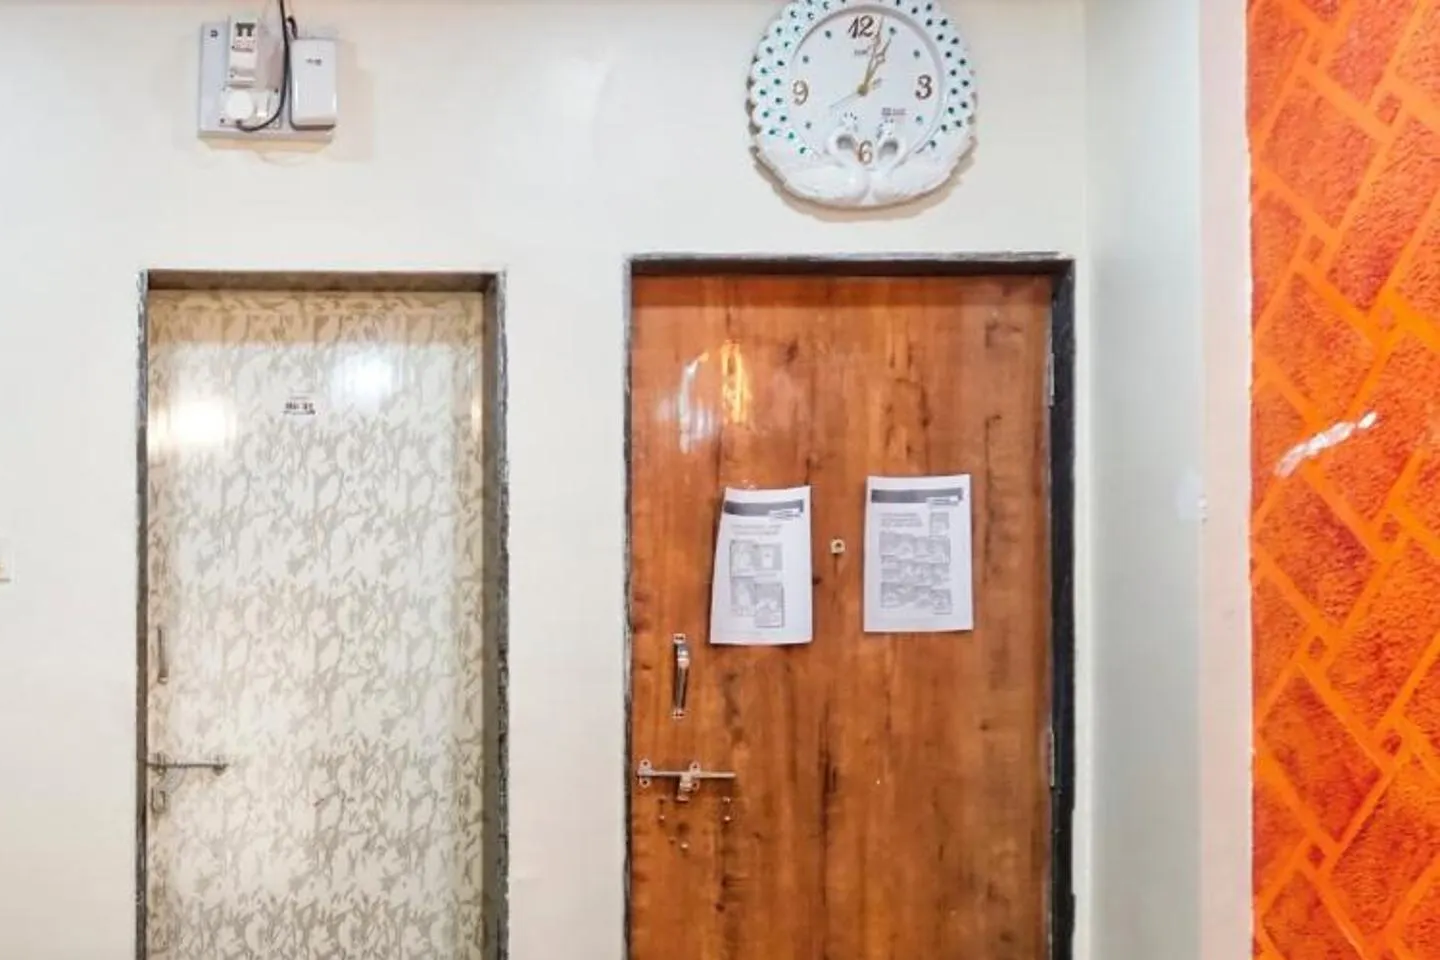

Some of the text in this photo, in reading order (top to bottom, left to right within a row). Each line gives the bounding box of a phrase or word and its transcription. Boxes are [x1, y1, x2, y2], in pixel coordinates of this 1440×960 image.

[848, 15, 874, 38] 12
[792, 80, 809, 105] 9
[915, 75, 932, 99] 3
[858, 141, 873, 164] 6
